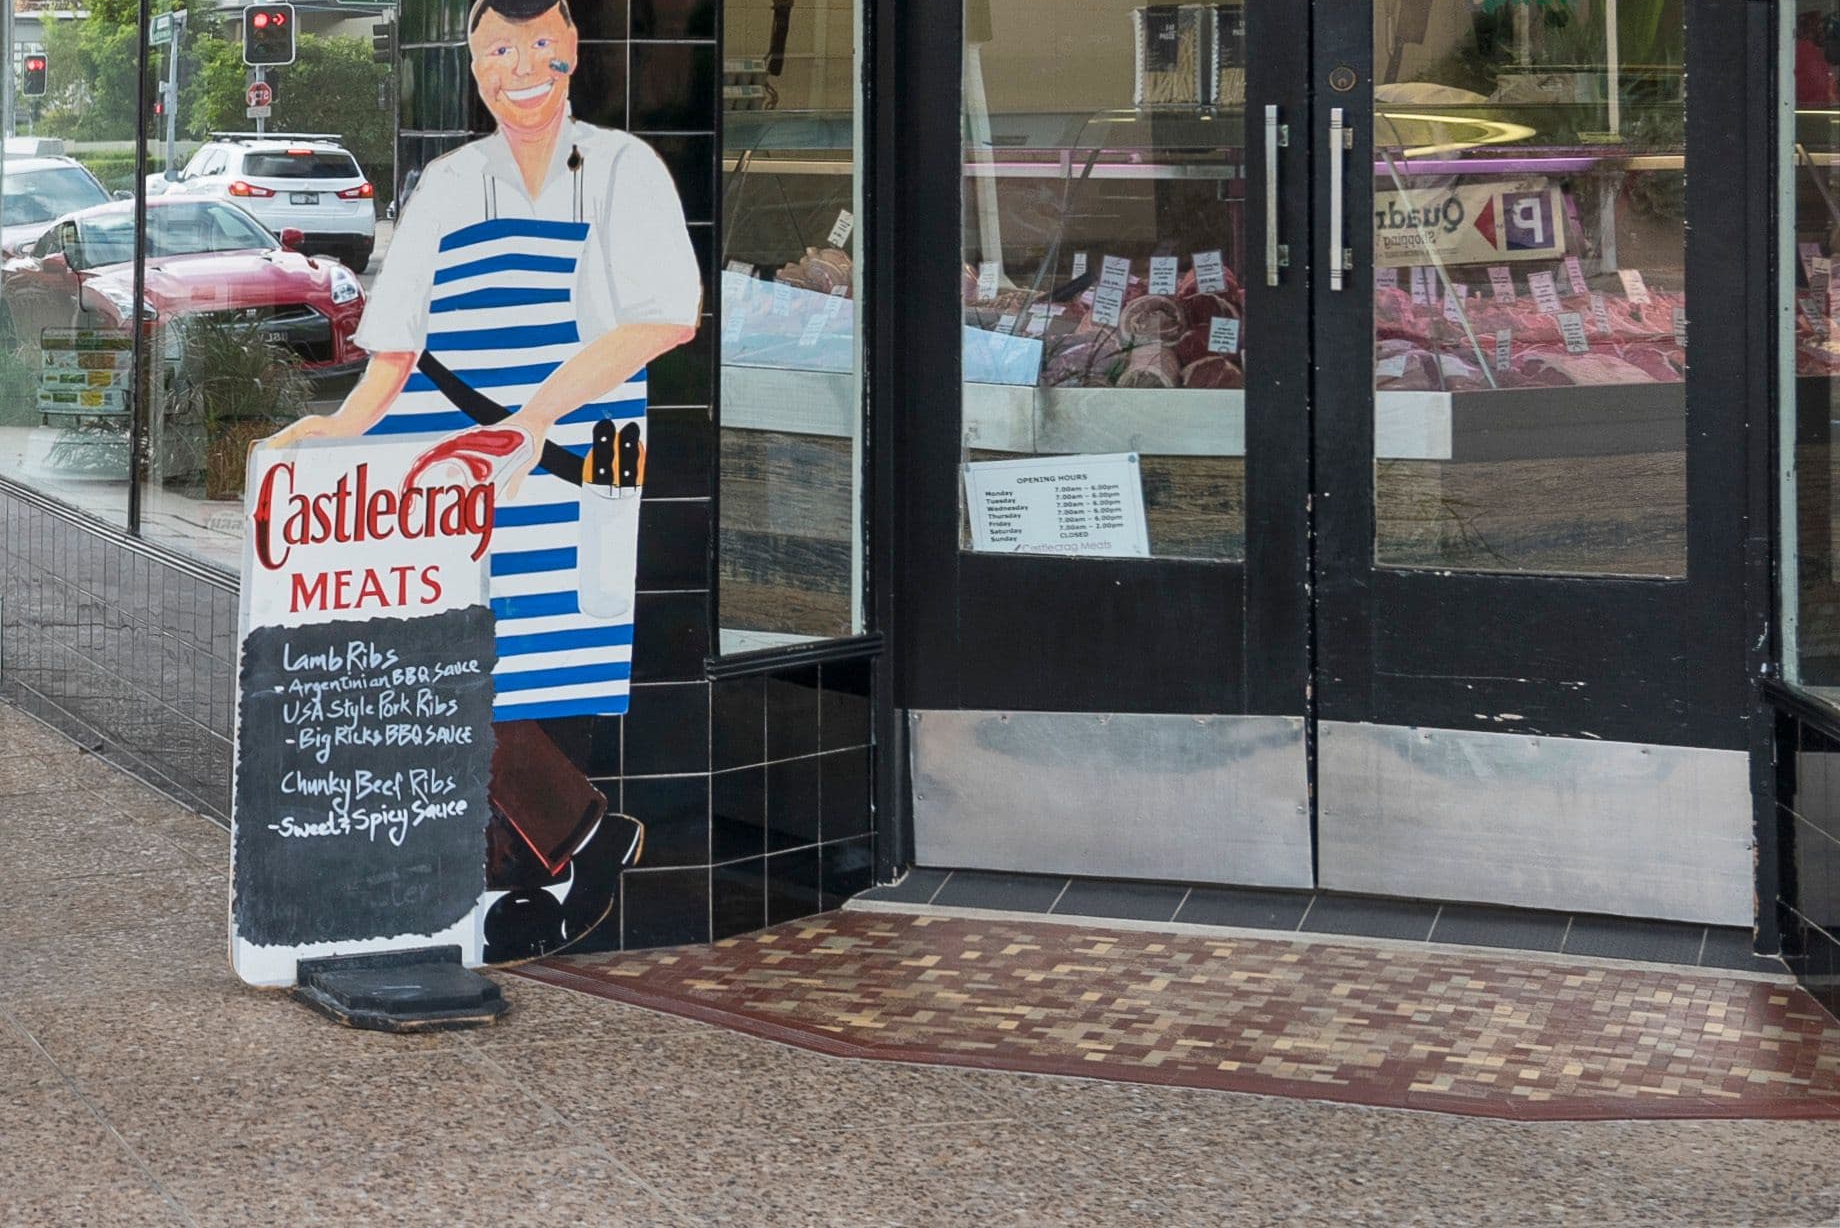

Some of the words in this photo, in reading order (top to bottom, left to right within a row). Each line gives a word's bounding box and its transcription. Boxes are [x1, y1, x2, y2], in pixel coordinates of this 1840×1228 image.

[1016, 475, 1056, 484] OPENING
[1058, 473, 1088, 481] HOURS
[253, 461, 495, 571] Castlecrag
[987, 504, 1028, 512] Wednesday
[1081, 540, 1112, 548] Meats
[289, 565, 443, 613] MEATS
[283, 642, 344, 672] Lamb
[347, 640, 400, 671] Ribs
[288, 674, 391, 700] Argentinian
[392, 665, 431, 686] BBQ
[283, 698, 324, 724] USA
[326, 695, 376, 729] Style
[378, 690, 413, 720] Pork
[416, 688, 459, 718] Ribs
[299, 727, 332, 764] Big
[386, 724, 423, 746] BBQ
[280, 770, 352, 814] Chunky
[355, 769, 404, 801] Beef
[409, 768, 457, 804] Ribs
[351, 803, 409, 847] Spicy
[411, 798, 469, 827] Sauce
